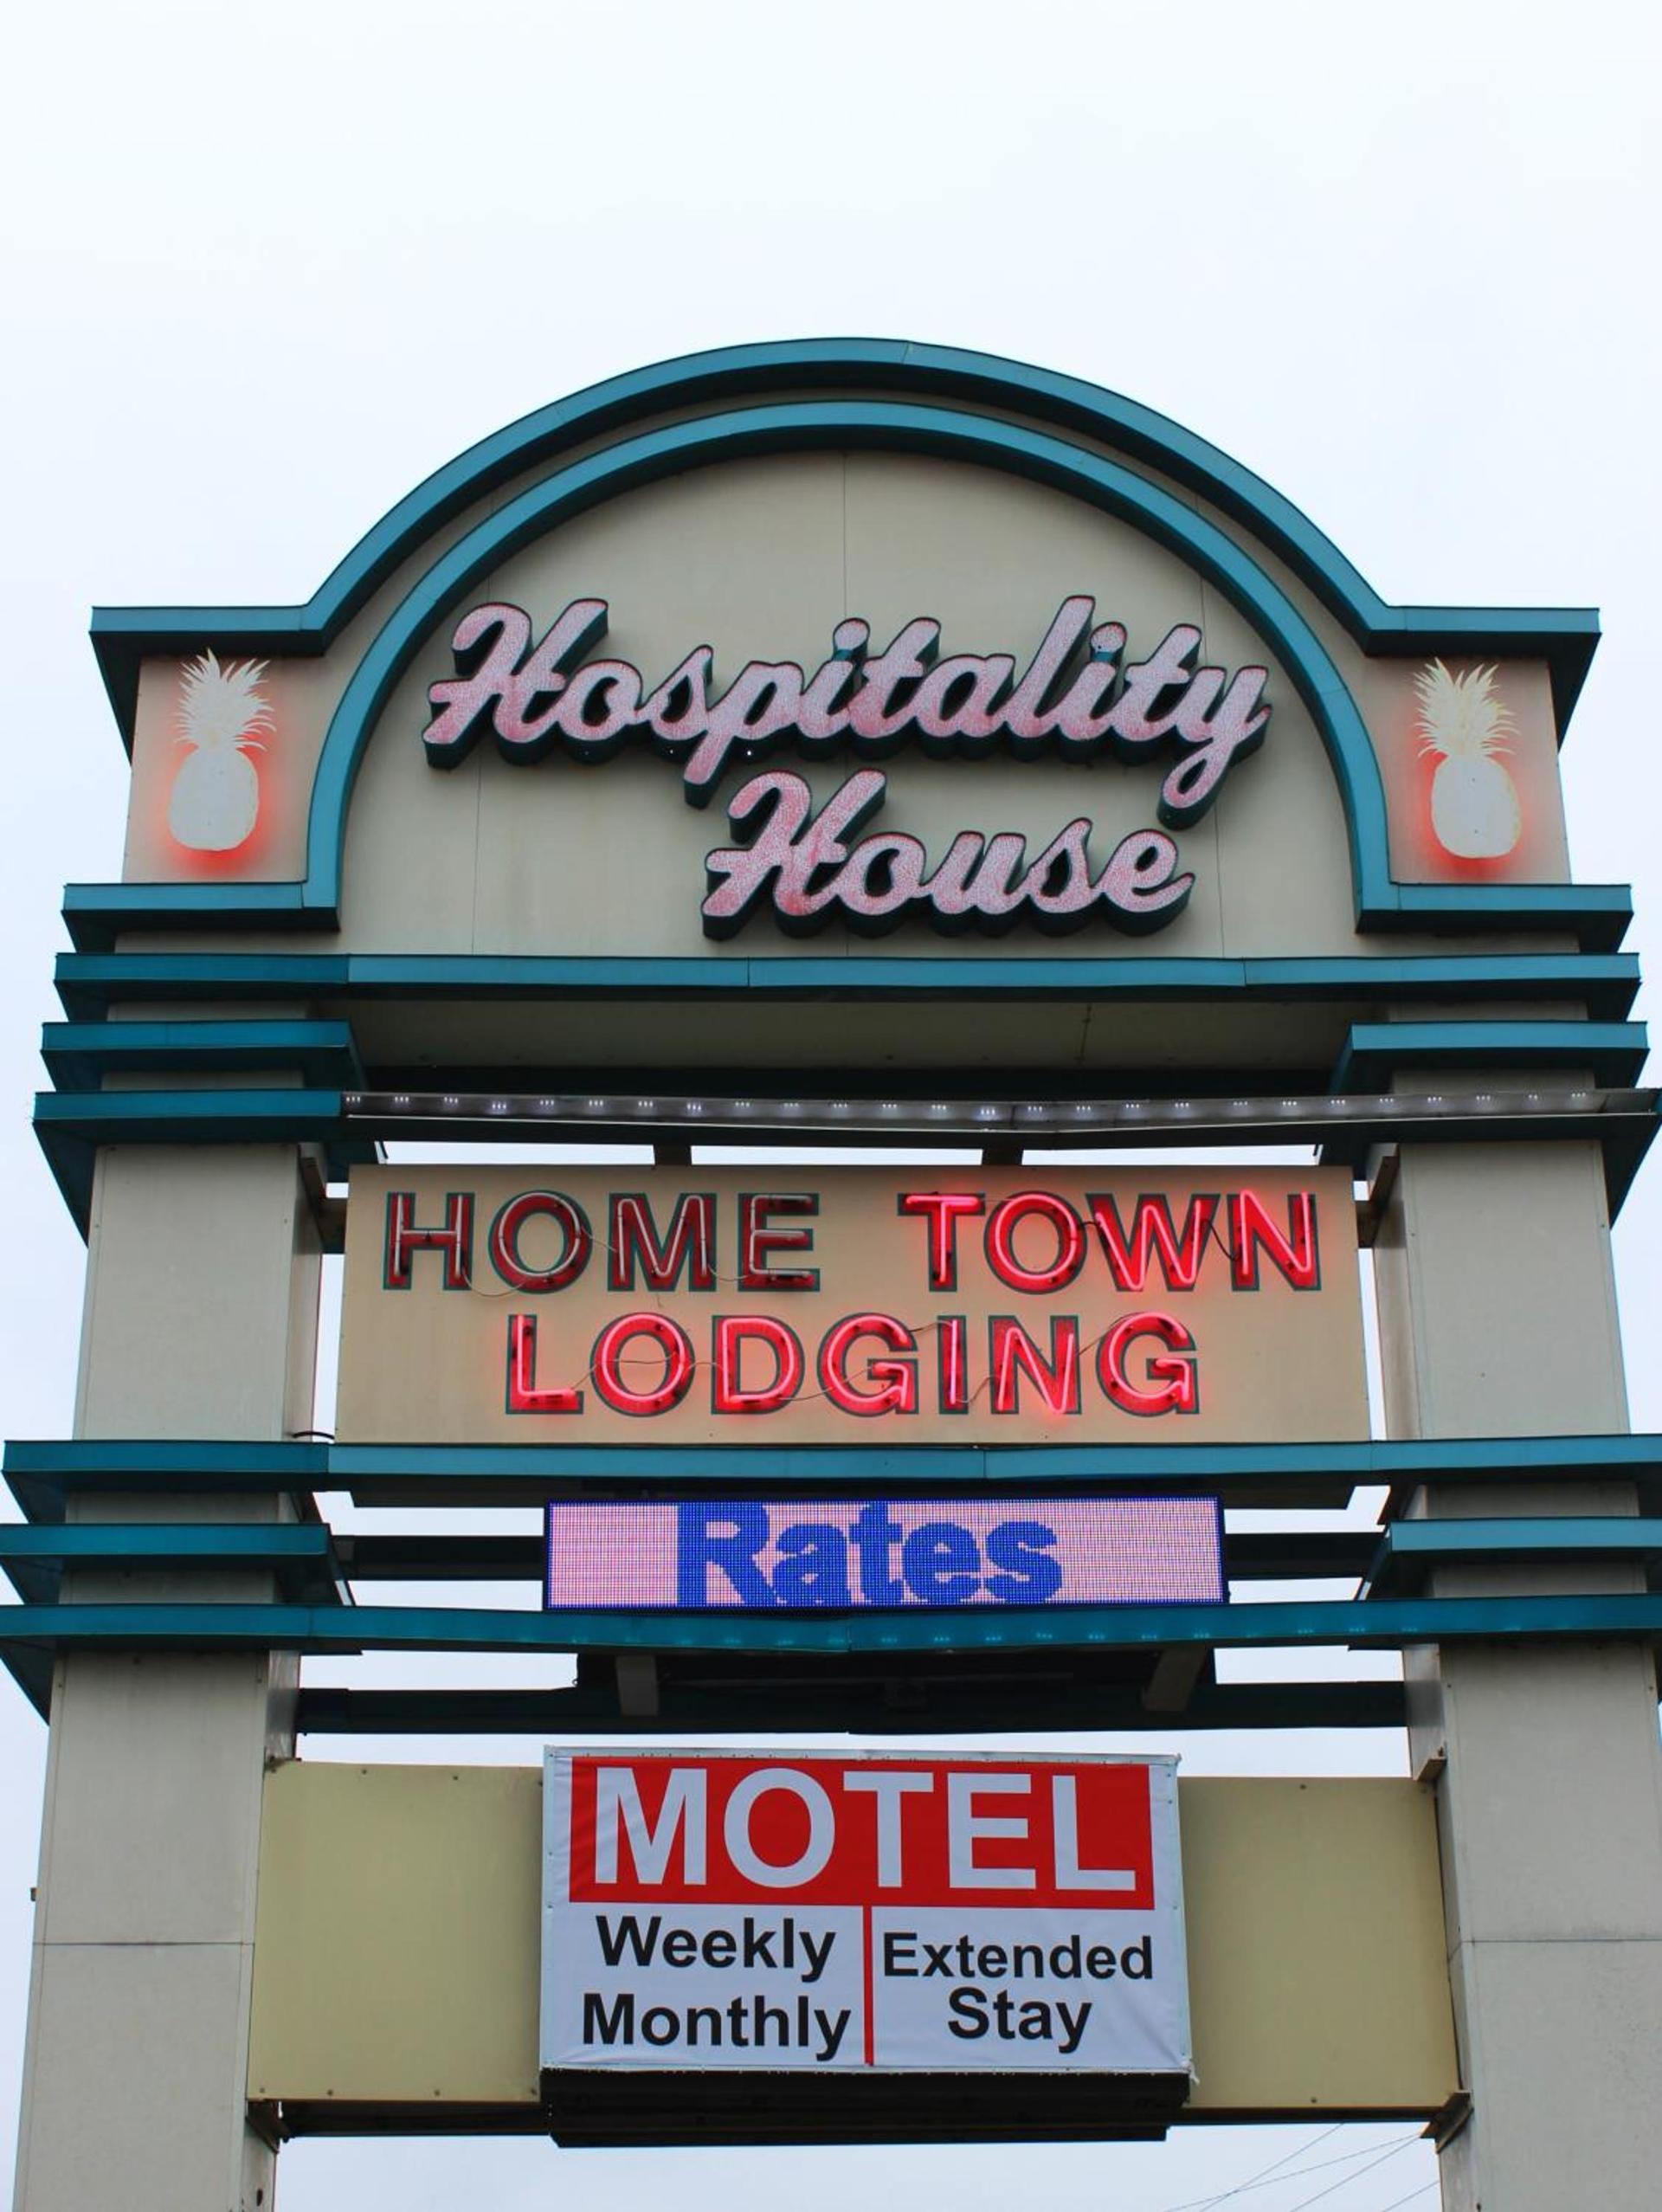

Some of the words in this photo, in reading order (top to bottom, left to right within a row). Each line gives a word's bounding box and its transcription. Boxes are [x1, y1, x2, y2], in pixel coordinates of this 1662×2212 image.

[422, 595, 1272, 818] Hospitality
[702, 770, 1195, 932] House
[384, 1191, 819, 1290] HOME
[899, 1191, 1321, 1290] TOWN
[507, 1312, 1199, 1416] LODGING
[676, 1502, 1063, 1607] Rates
[594, 1767, 1137, 1891] MOTEL
[596, 1914, 836, 1983] Weekly
[882, 1931, 1154, 1980] Extended
[583, 1993, 852, 2061] Monthly
[948, 1987, 1092, 2054] Stay
